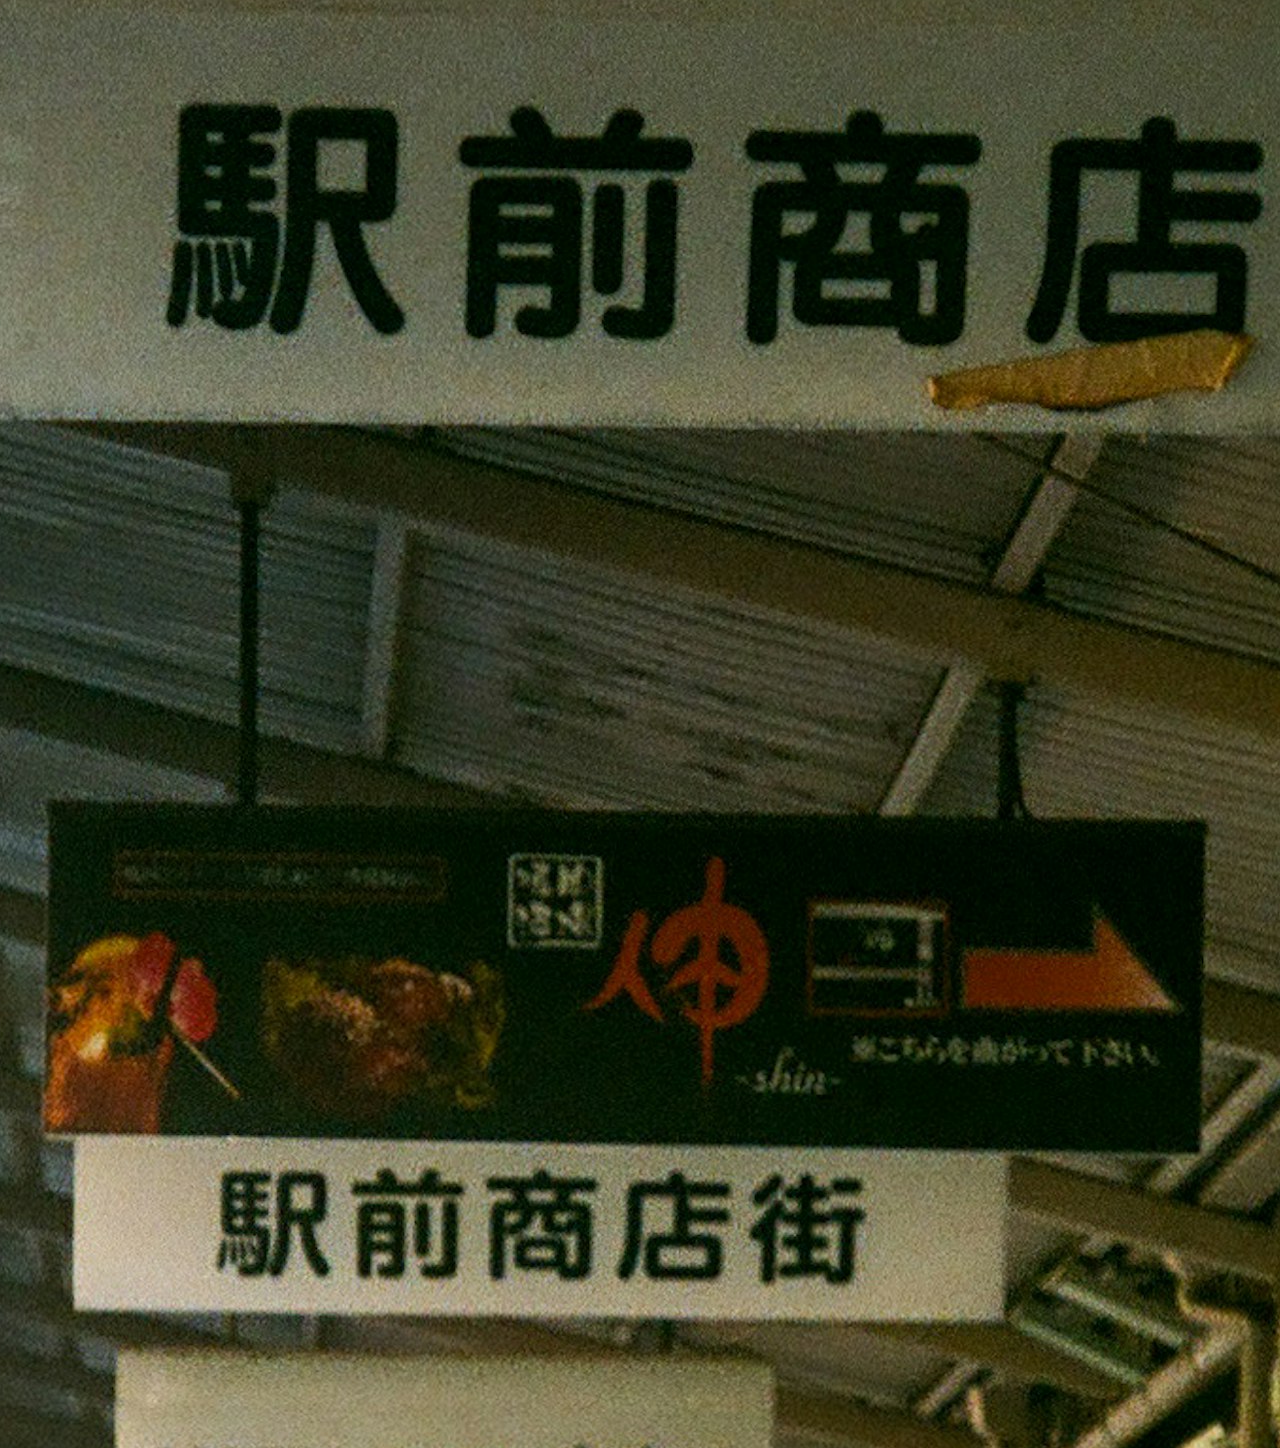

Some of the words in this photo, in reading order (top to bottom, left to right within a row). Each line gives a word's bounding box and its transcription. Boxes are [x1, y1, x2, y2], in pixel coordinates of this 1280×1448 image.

[216, 1167, 867, 1287] 駅前商店街
